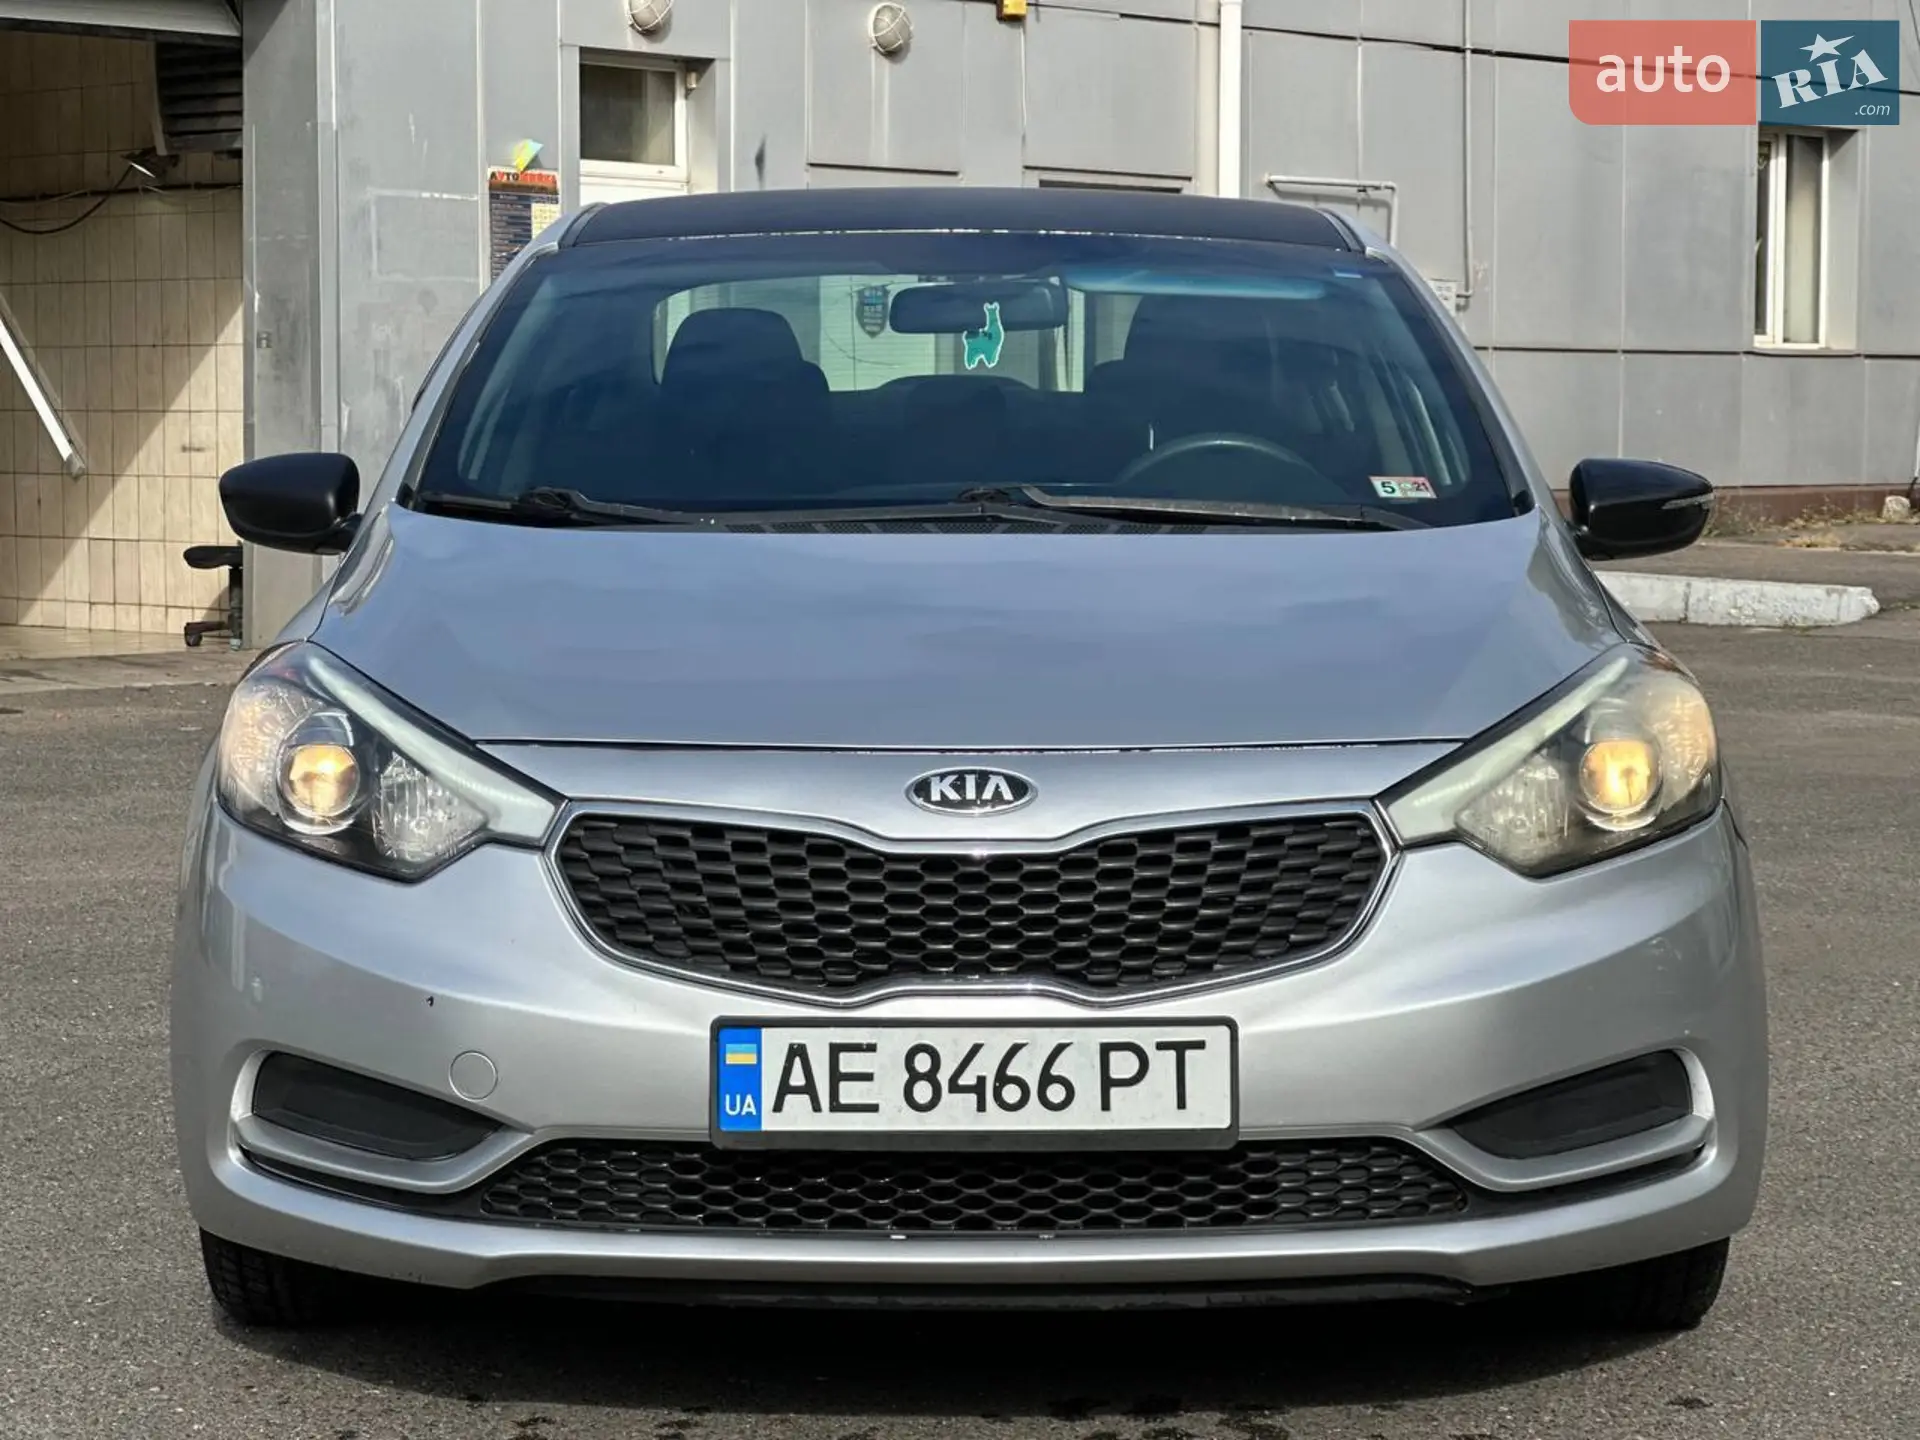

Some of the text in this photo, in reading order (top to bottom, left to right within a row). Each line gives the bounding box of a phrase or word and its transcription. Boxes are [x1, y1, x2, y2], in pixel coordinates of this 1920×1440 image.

[1380, 480, 1396, 494] 5
[929, 773, 1015, 802] KIA
[771, 1039, 1207, 1114] AE 8466 PT
[724, 1093, 757, 1116] UA
